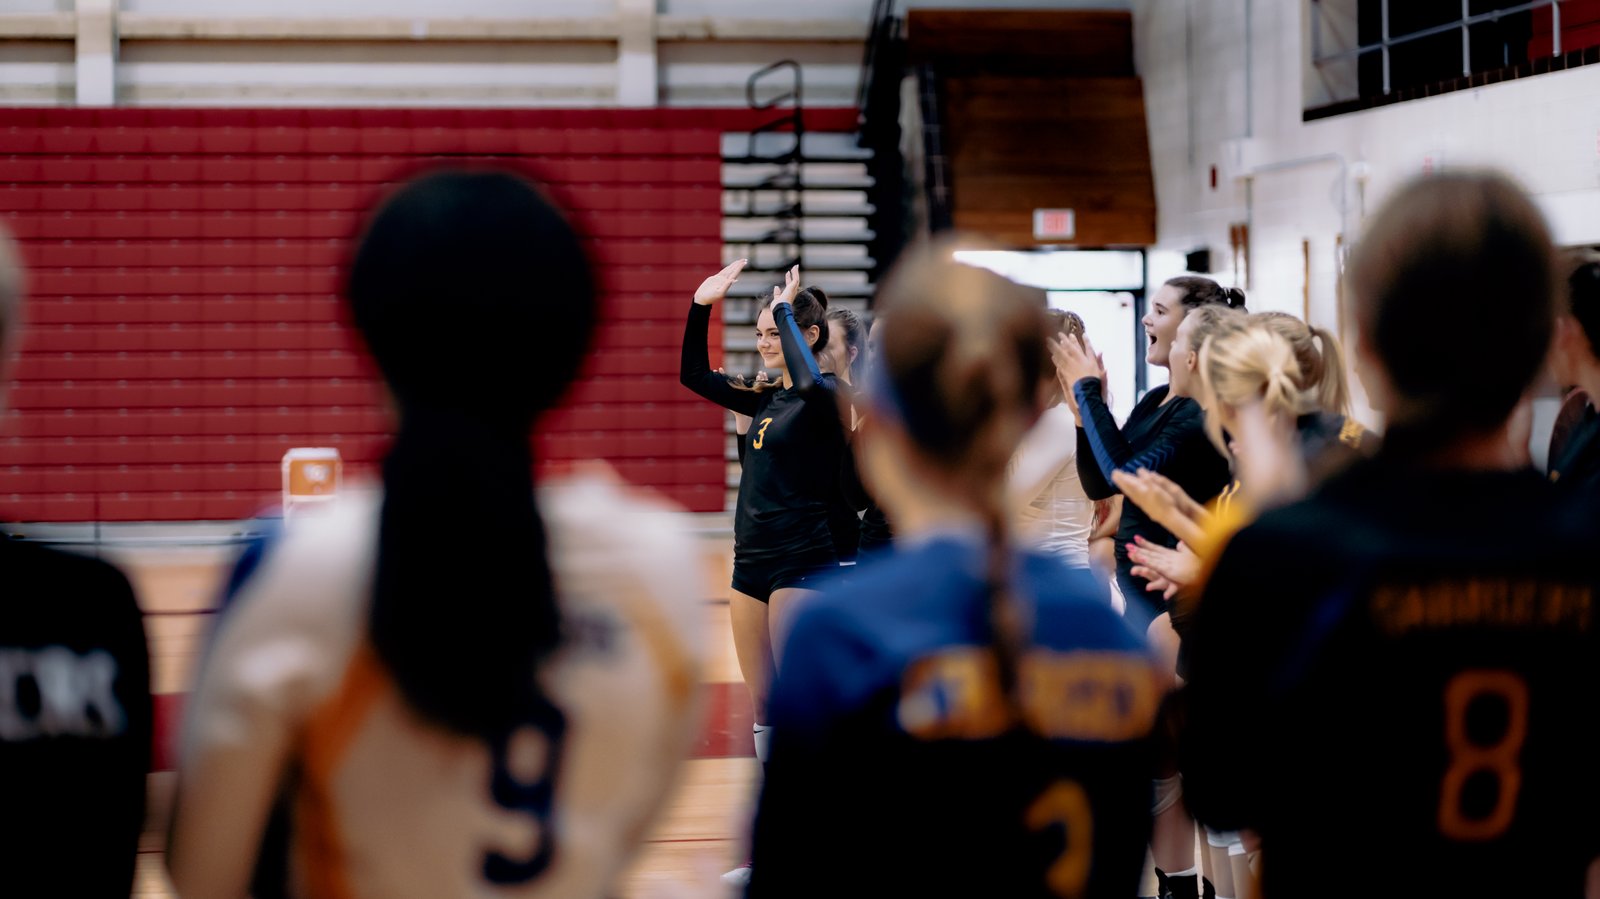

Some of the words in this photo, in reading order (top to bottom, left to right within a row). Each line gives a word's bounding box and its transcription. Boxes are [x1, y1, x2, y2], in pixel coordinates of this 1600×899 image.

[753, 417, 773, 450] 3
[484, 702, 564, 886] 9
[1438, 668, 1529, 841] 8
